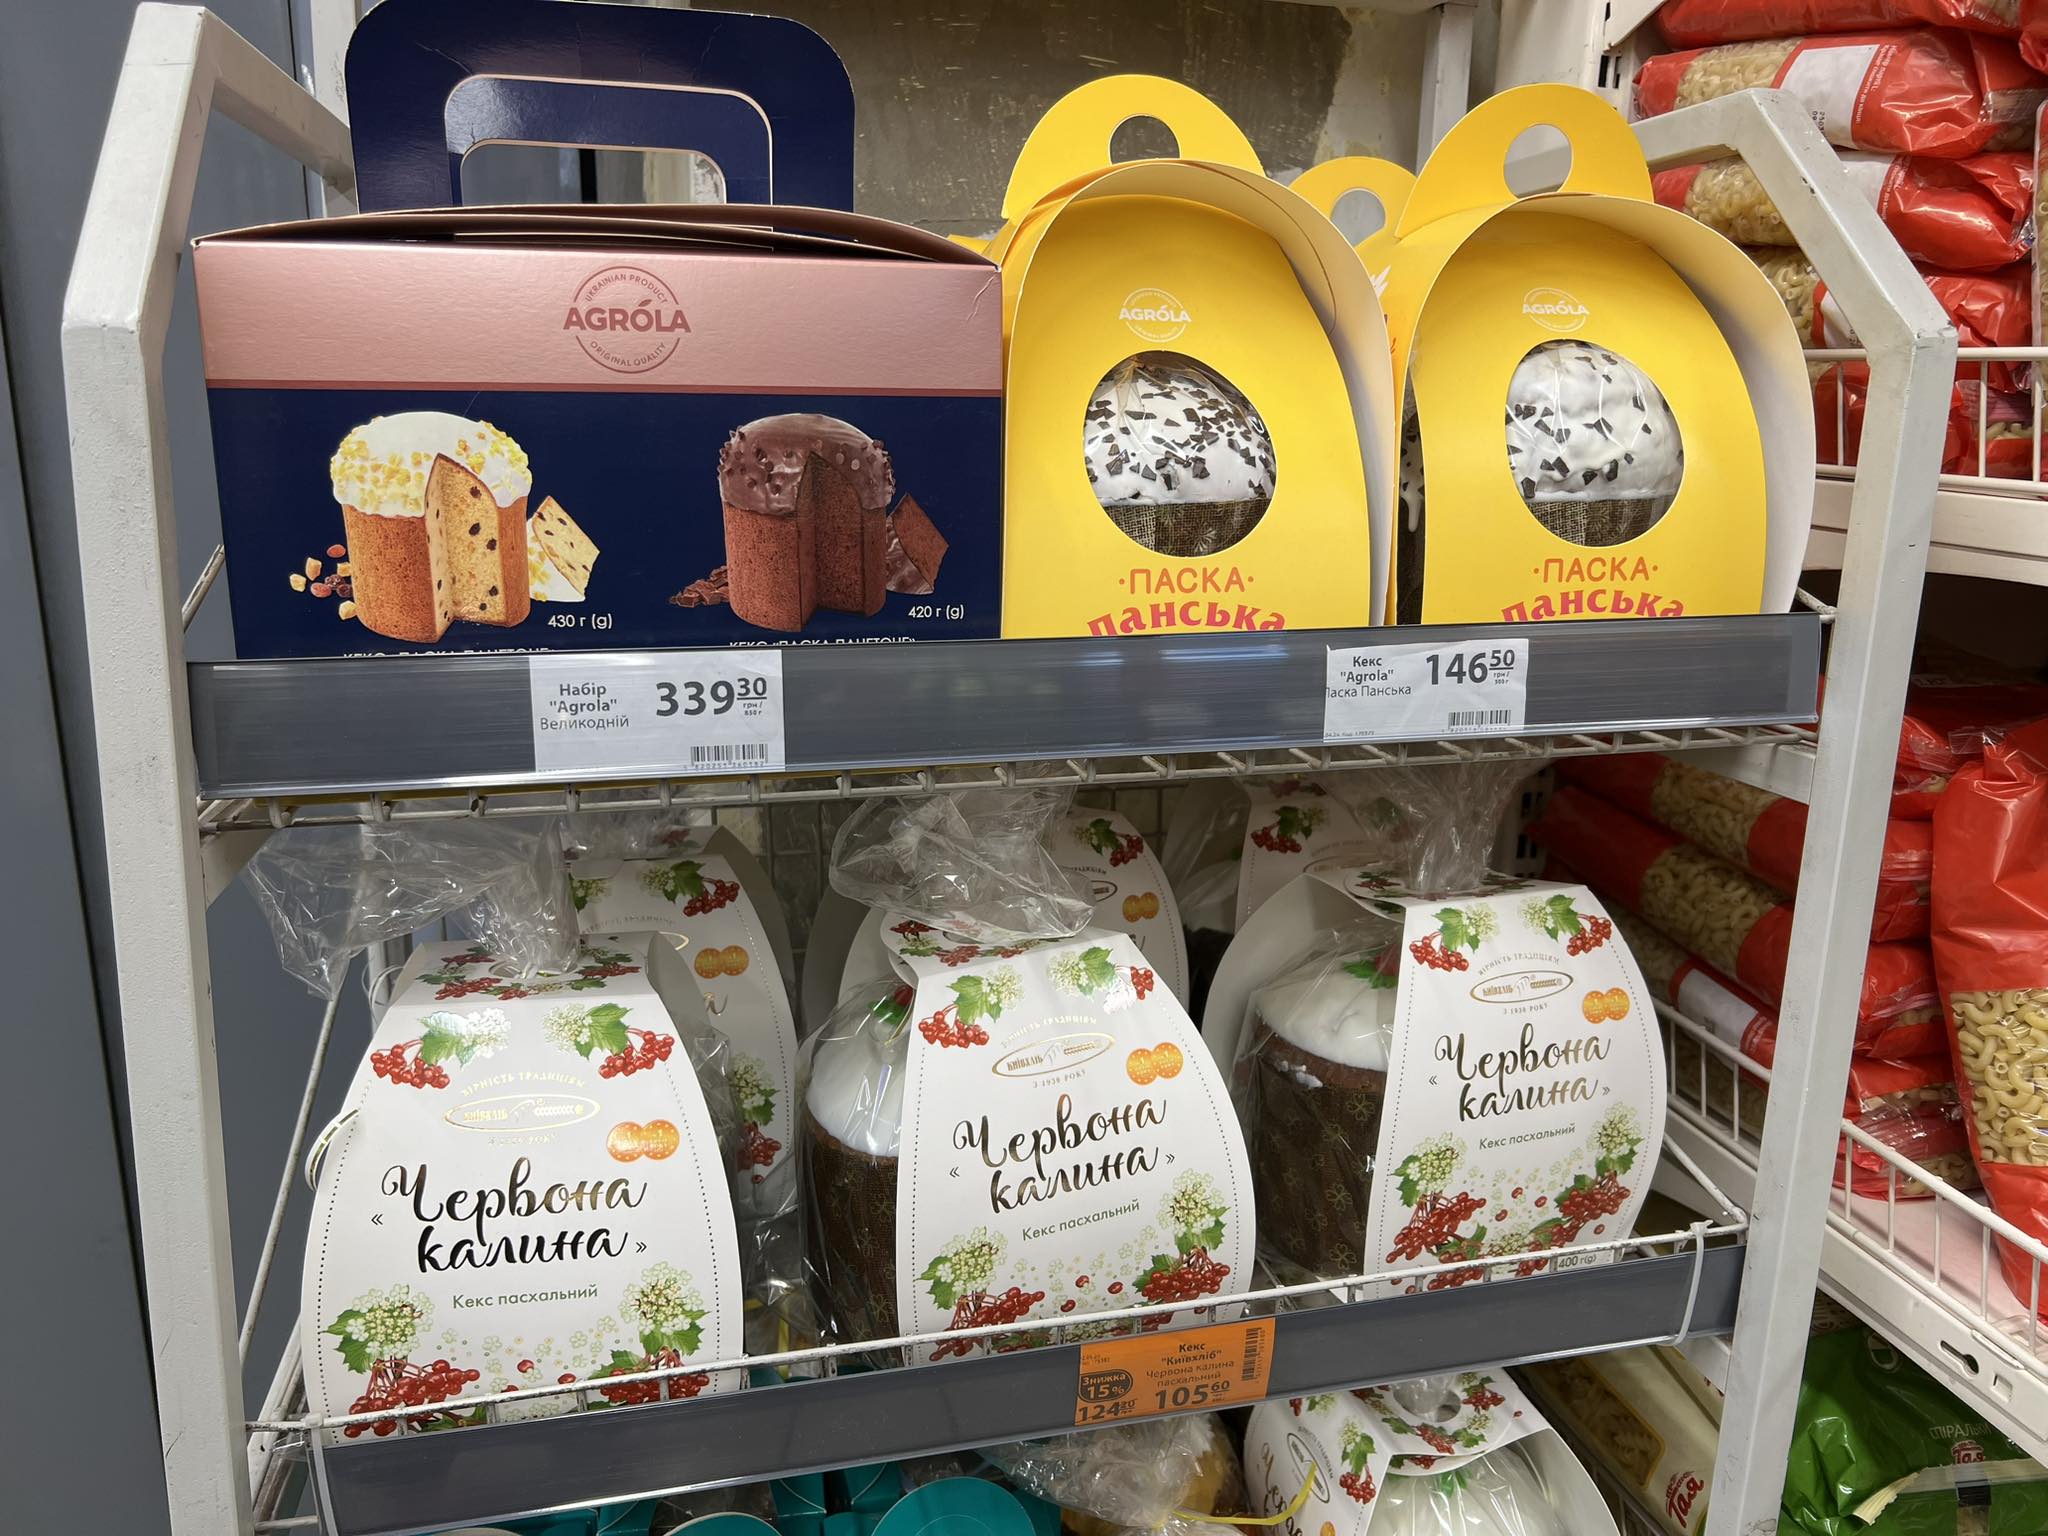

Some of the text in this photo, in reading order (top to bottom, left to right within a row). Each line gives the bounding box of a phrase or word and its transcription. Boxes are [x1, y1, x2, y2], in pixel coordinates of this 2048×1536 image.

[585, 274, 668, 304] UKRAINIAN PRODUCT
[590, 341, 666, 367] ORIGINAL QUALITY
[908, 605, 932, 618] 420
[946, 605, 964, 619] (g)
[548, 614, 575, 628] 430
[592, 613, 613, 630] (g)
[1353, 656, 1383, 667] Кекс
[1426, 649, 1515, 685] 146 50
[1340, 669, 1394, 685] "Agrola"
[559, 682, 607, 698] Набір
[656, 677, 767, 717] 339 30
[1361, 685, 1412, 697] Панська
[550, 697, 617, 715] "Agrola"
[743, 702, 758, 710] грн
[540, 714, 630, 731] Великодній
[1479, 1122, 1576, 1149] Кекс пасхальний
[1022, 1198, 1140, 1241] Кекс пасхальний
[1559, 1255, 1579, 1268] 400
[453, 1284, 598, 1309] Кекс пасхальний
[1179, 1343, 1206, 1353] Кекс
[1146, 1360, 1235, 1379] Червона калина
[1082, 1373, 1126, 1386] Знижка
[1157, 1371, 1222, 1387] пасхальний
[1155, 1383, 1209, 1410] 105
[1211, 1380, 1231, 1392] 60
[1078, 1401, 1120, 1422] 124
